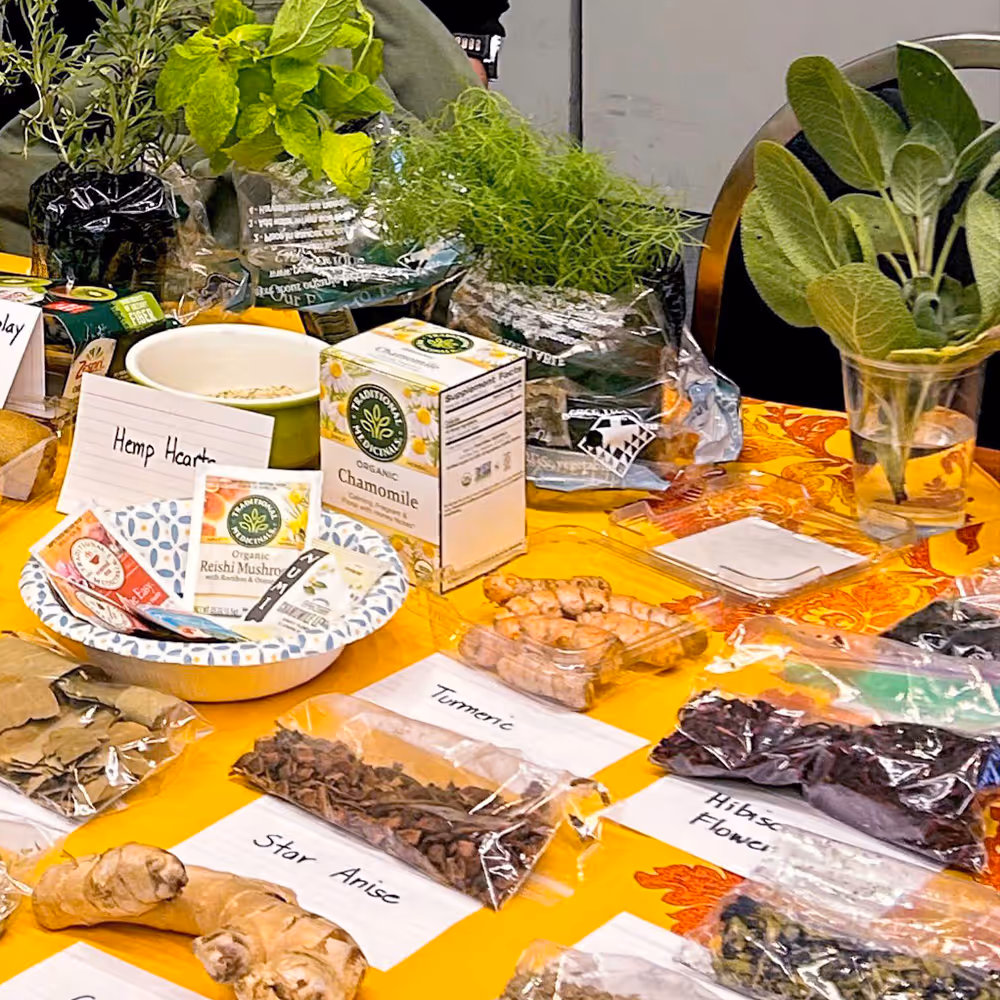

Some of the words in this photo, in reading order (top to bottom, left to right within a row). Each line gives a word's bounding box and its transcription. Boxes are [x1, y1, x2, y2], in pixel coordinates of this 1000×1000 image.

[444, 376, 496, 403] Supplement
[499, 364, 523, 379] Facts
[351, 389, 403, 426] TRADITIONAL
[113, 425, 155, 468] Hemp
[352, 424, 403, 457] MEDICINALS
[338, 467, 419, 510] Chamomile
[356, 460, 399, 481] ORGANIC
[231, 498, 279, 521] TRADITIONAL
[231, 526, 277, 546] MEDICINALS
[200, 560, 235, 573] Reishi
[231, 550, 270, 561] Organic
[431, 683, 515, 731] Turmeric
[704, 791, 783, 832] Hibisc
[252, 834, 317, 864] Star
[328, 867, 400, 904] Anise
